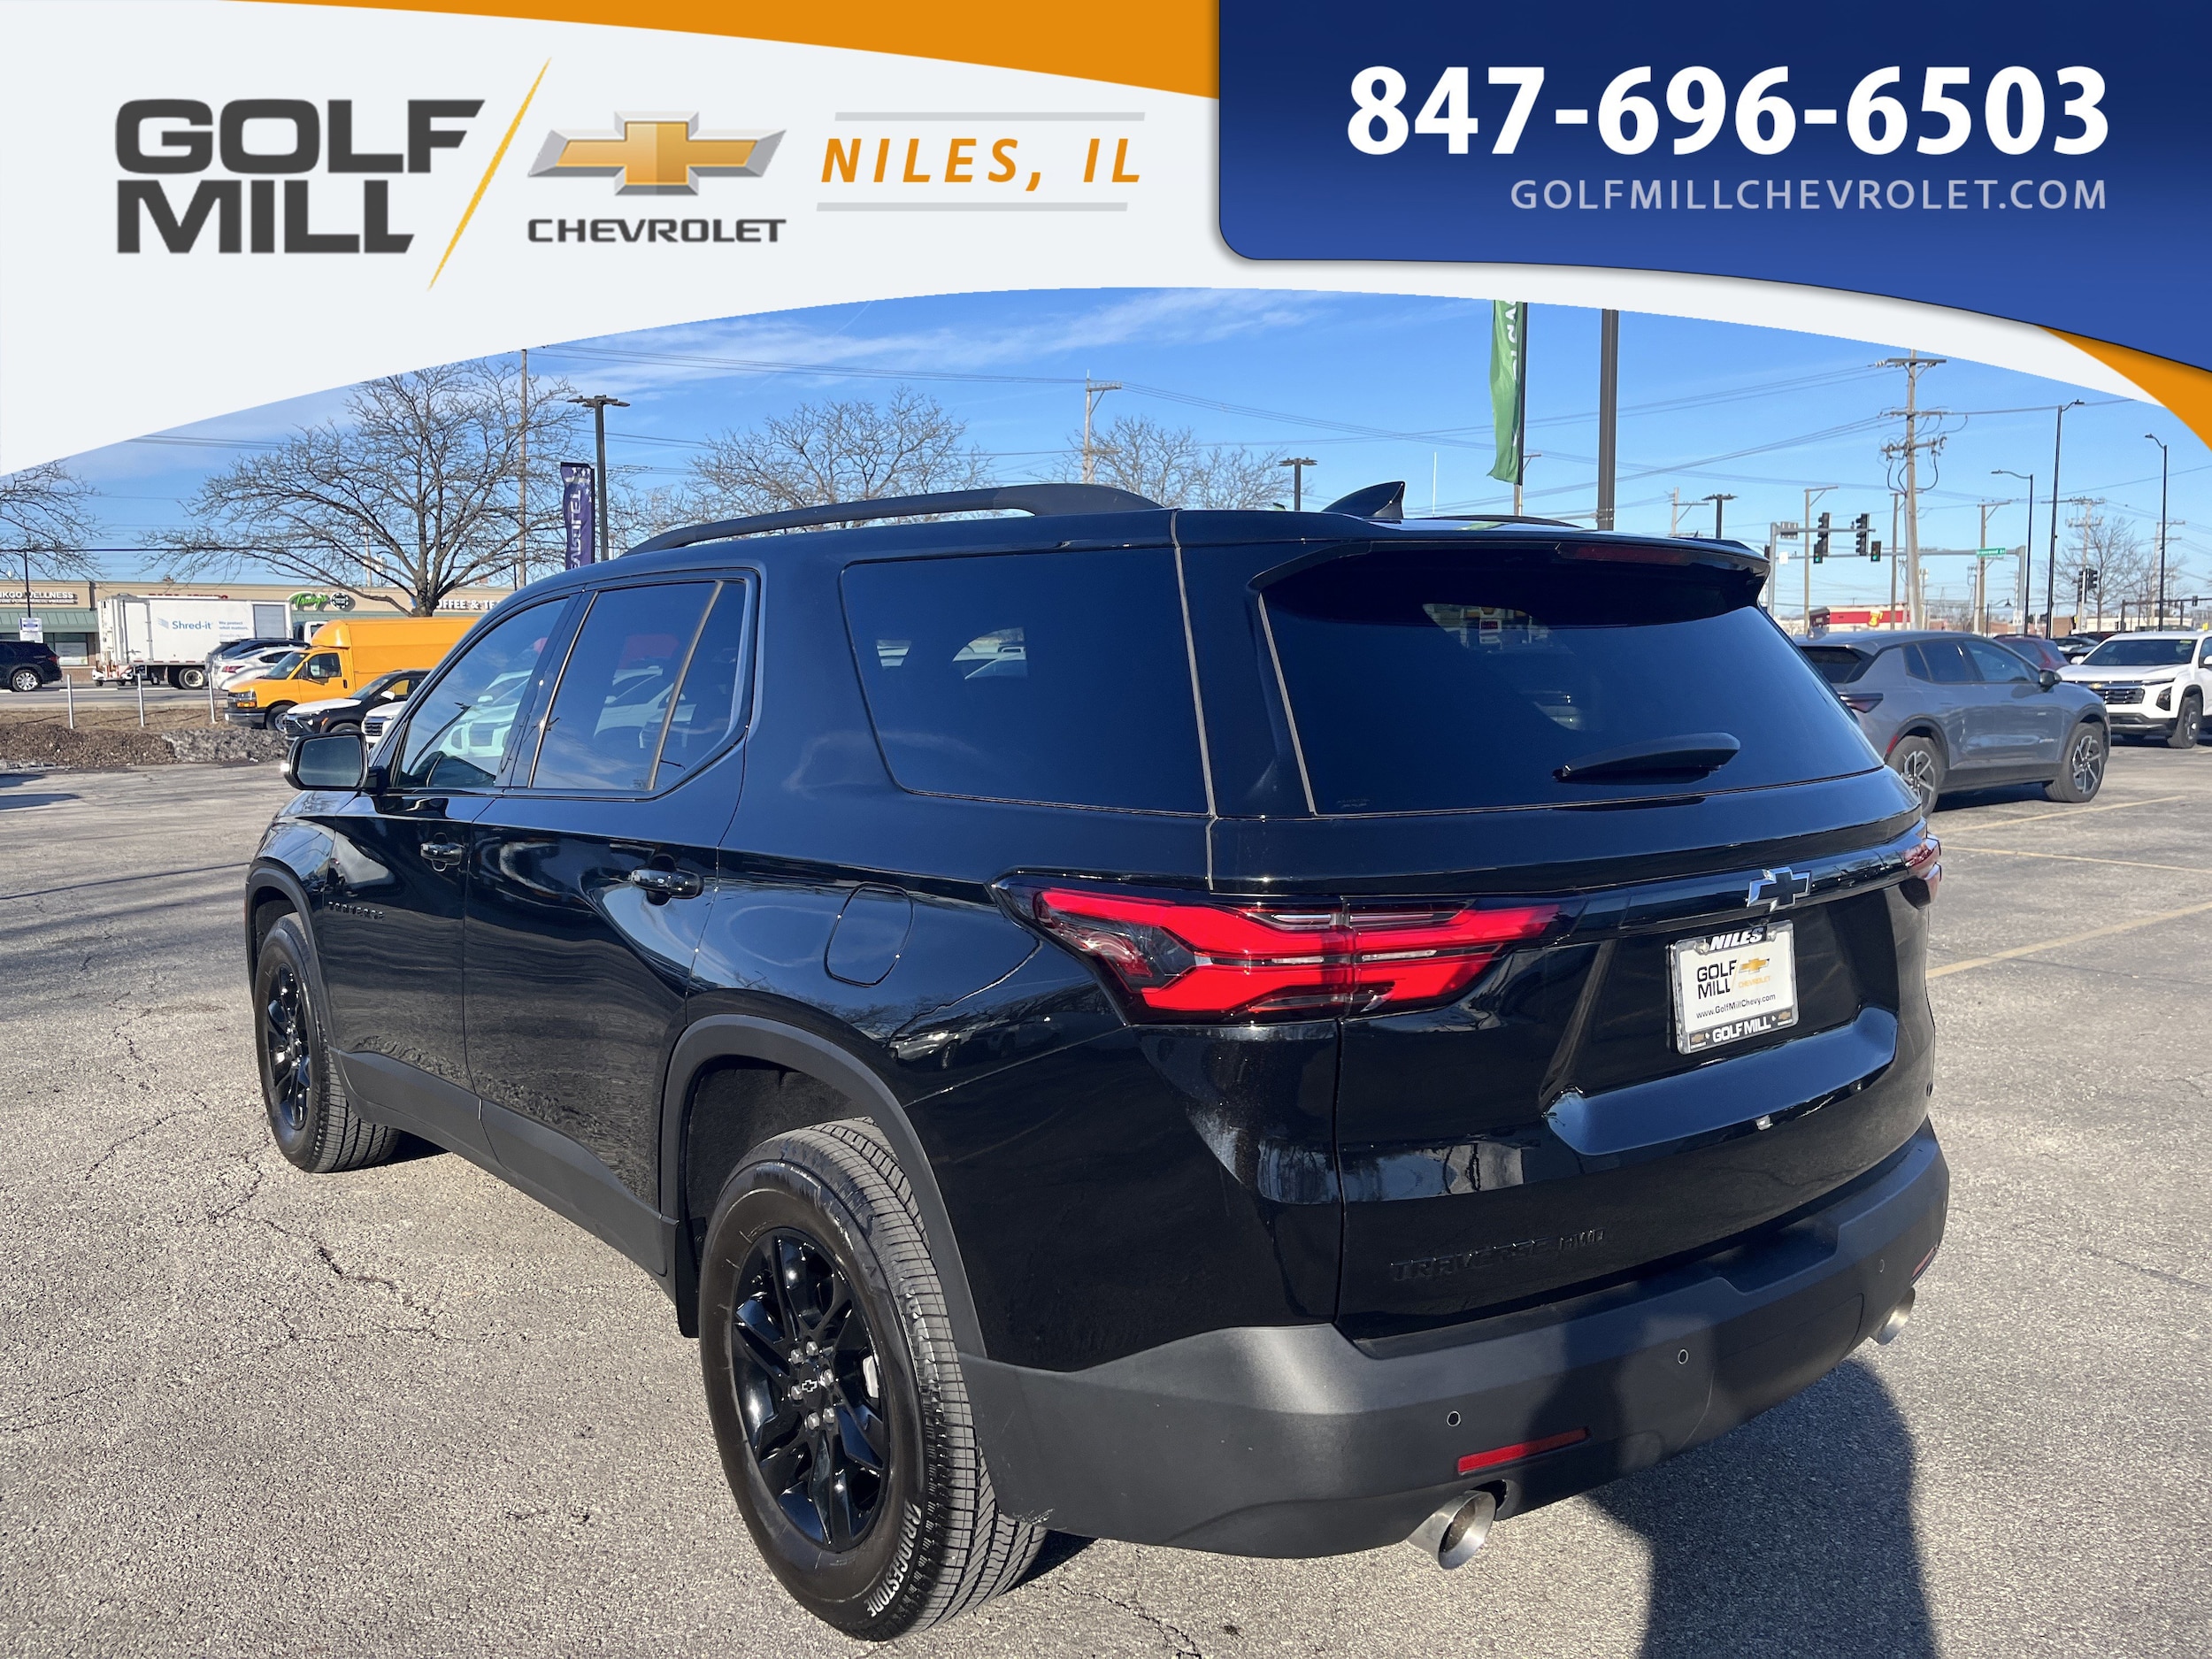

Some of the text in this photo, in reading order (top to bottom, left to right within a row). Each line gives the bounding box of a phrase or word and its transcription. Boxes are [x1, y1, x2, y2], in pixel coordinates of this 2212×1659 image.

[436, 599, 501, 609] OFFEE & TE
[172, 620, 211, 630] Shred-it
[1709, 926, 1764, 951] NILES
[1697, 959, 1738, 983] GOLF
[1697, 978, 1731, 1000] MILL
[1695, 994, 1777, 1019] www.GolfMillChevy.com
[1712, 1016, 1772, 1044] GOLF MILL
[863, 1497, 923, 1618] BRIDGESTONE
